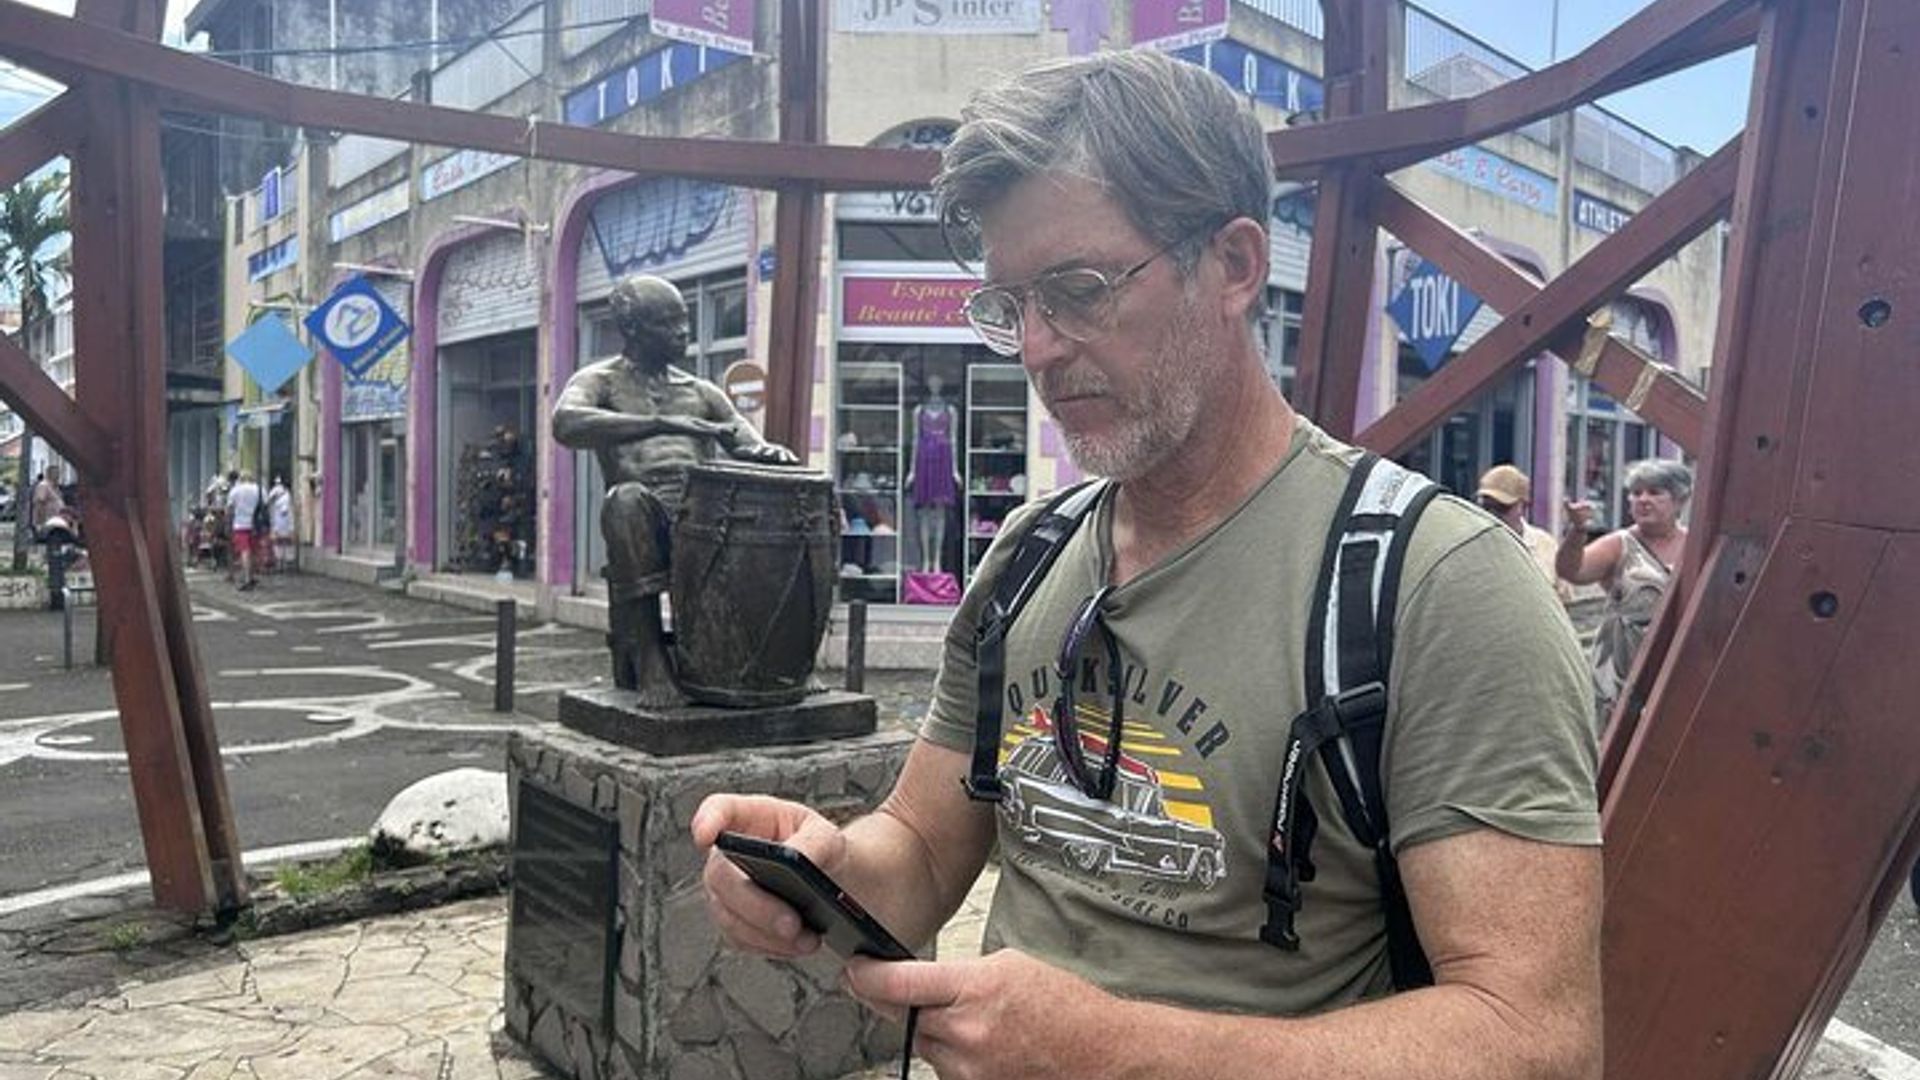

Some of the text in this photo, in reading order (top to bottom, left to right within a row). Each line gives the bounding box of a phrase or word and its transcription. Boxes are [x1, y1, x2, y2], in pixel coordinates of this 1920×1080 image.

[597, 43, 707, 121] TOKI
[1409, 273, 1459, 341] TOKI
[1007, 657, 1231, 761] QUKILVER
